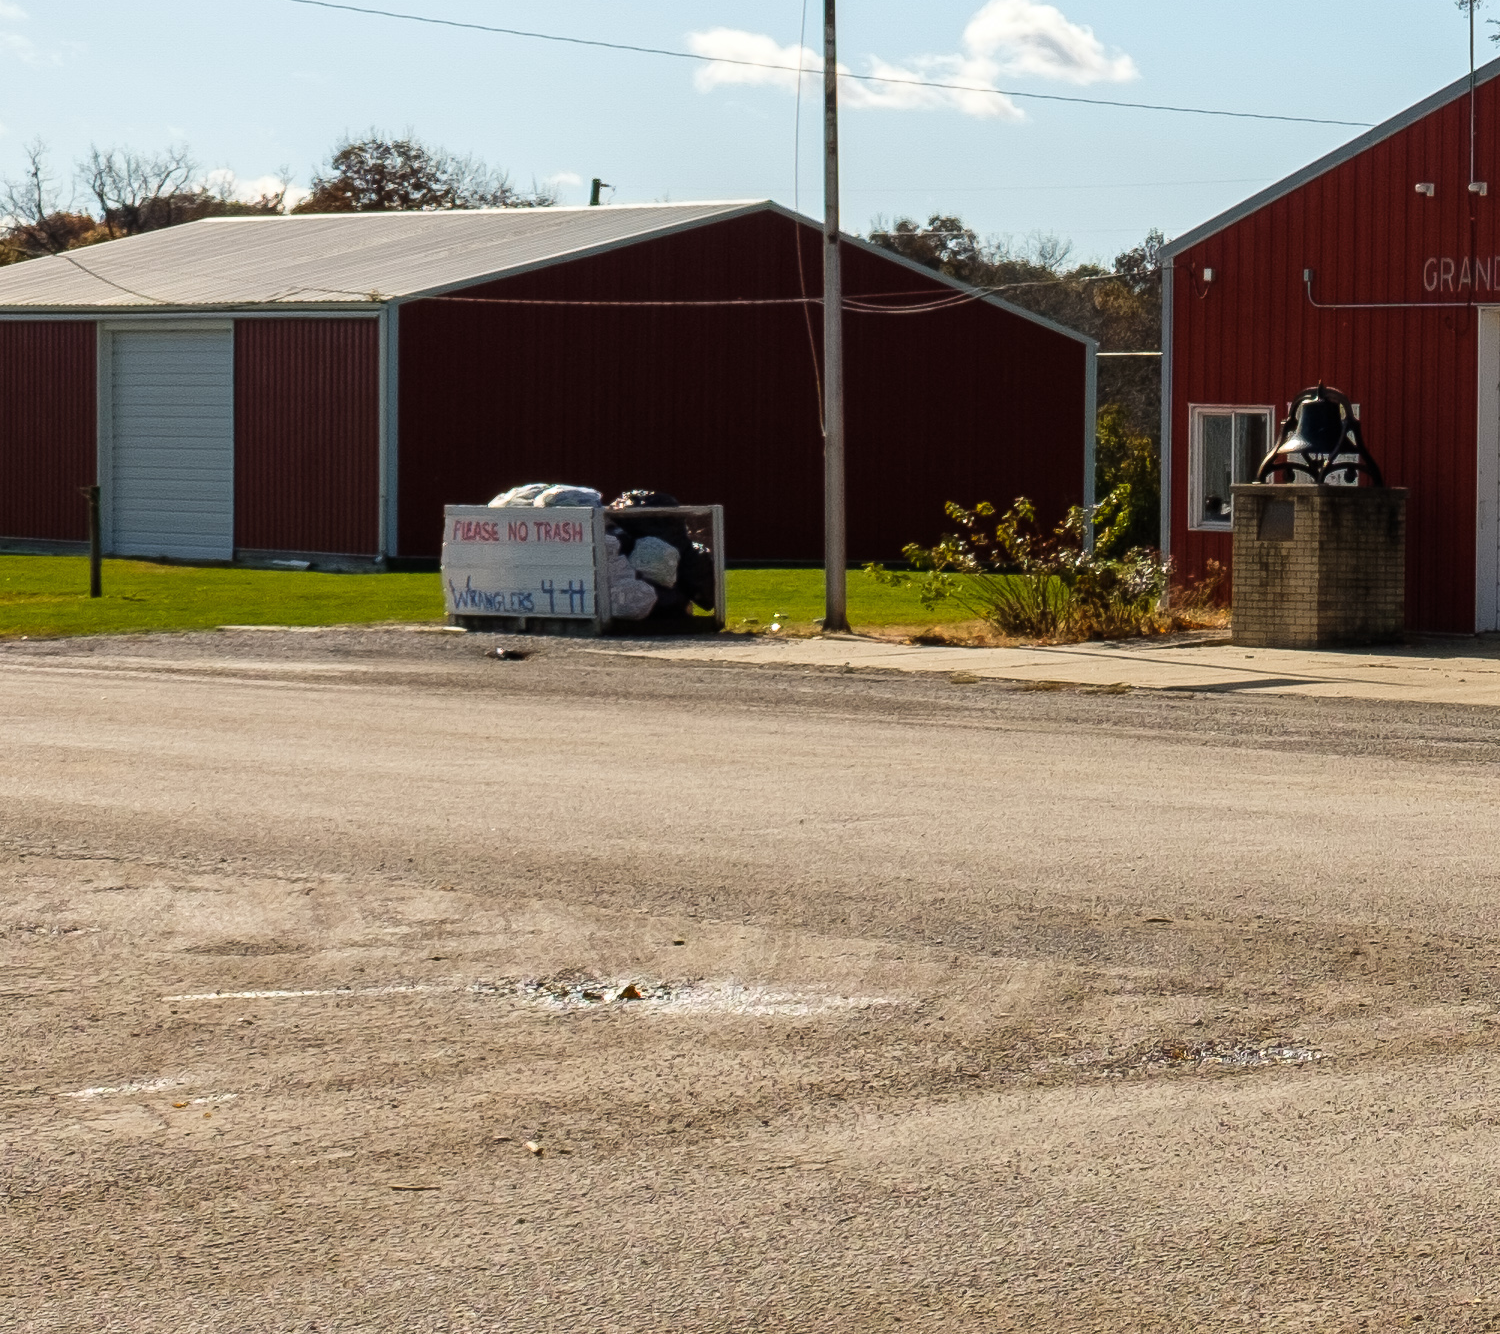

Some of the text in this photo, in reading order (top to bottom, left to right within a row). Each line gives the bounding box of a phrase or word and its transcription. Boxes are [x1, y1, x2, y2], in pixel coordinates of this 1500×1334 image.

[453, 520, 583, 542] PLEASE NO TRASH
[541, 579, 586, 613] 4-H
